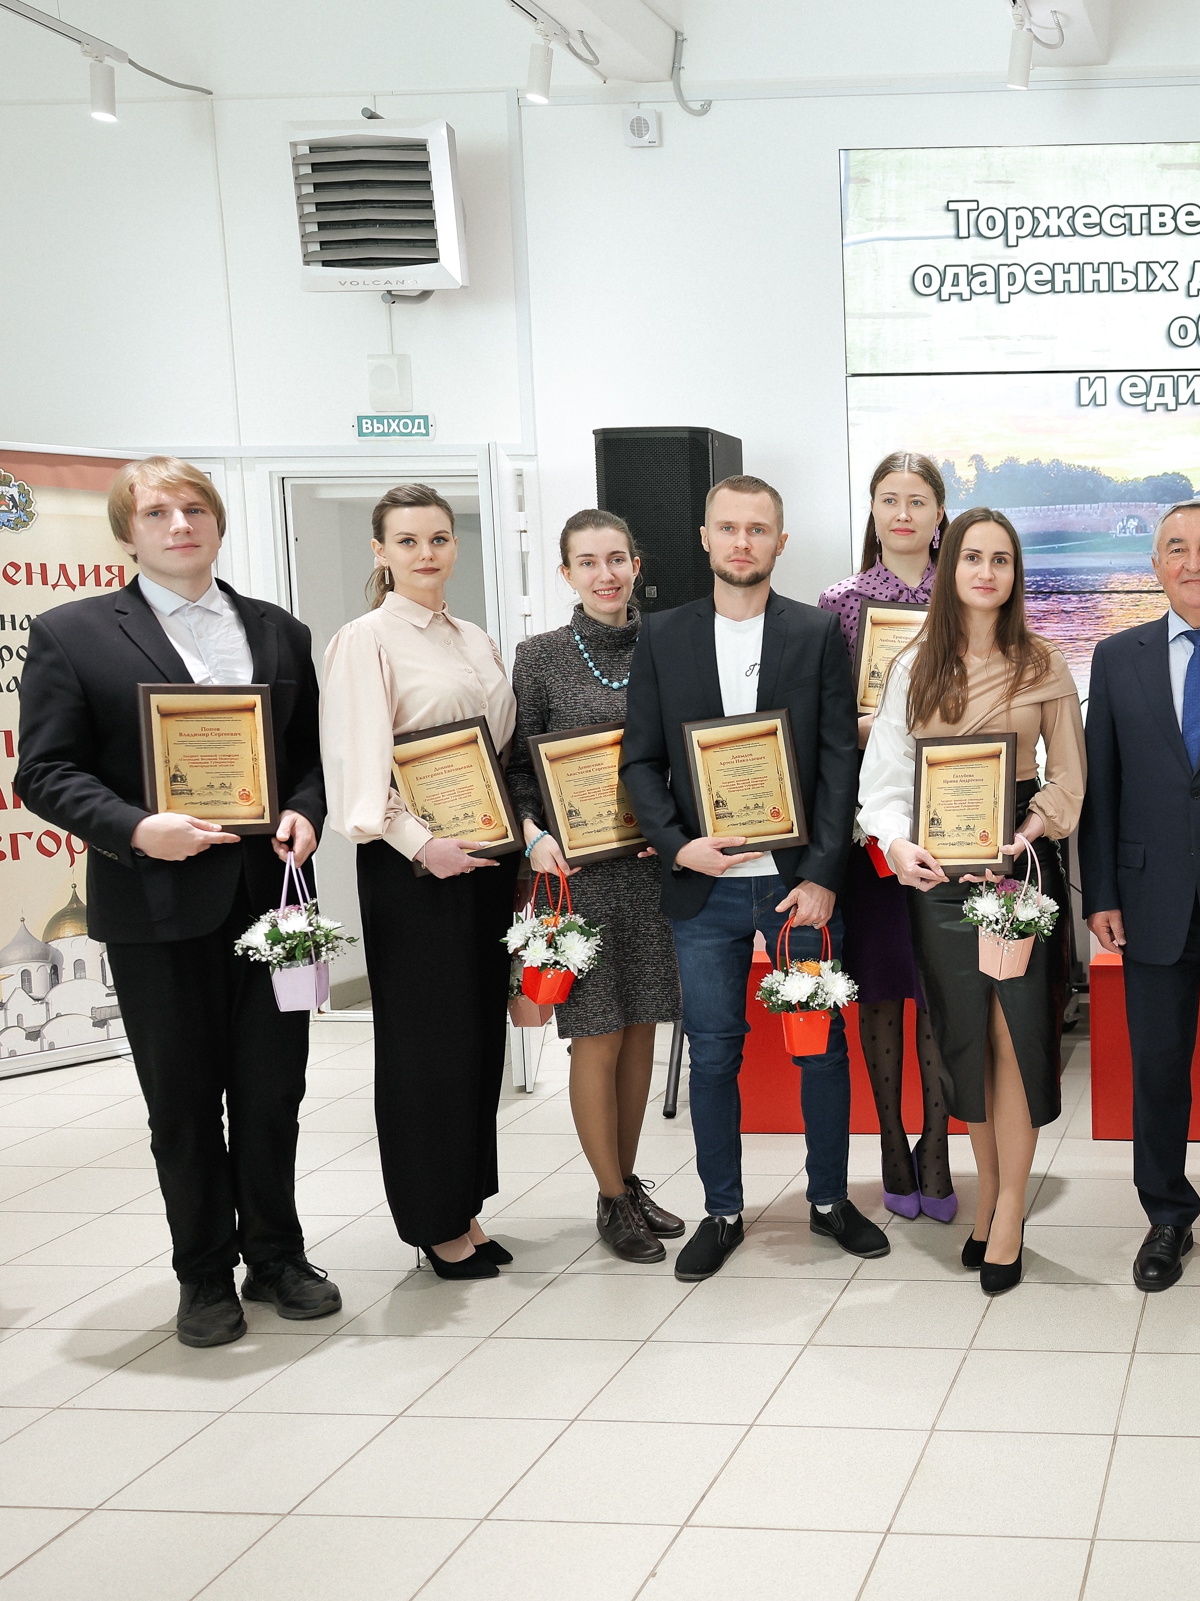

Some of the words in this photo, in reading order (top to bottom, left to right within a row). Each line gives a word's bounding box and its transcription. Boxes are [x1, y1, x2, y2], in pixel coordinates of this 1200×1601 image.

[913, 259, 1179, 303] одаренных
[1078, 376, 1106, 407] и
[362, 419, 426, 434] ВЫХОД
[2, 561, 126, 592] ендия
